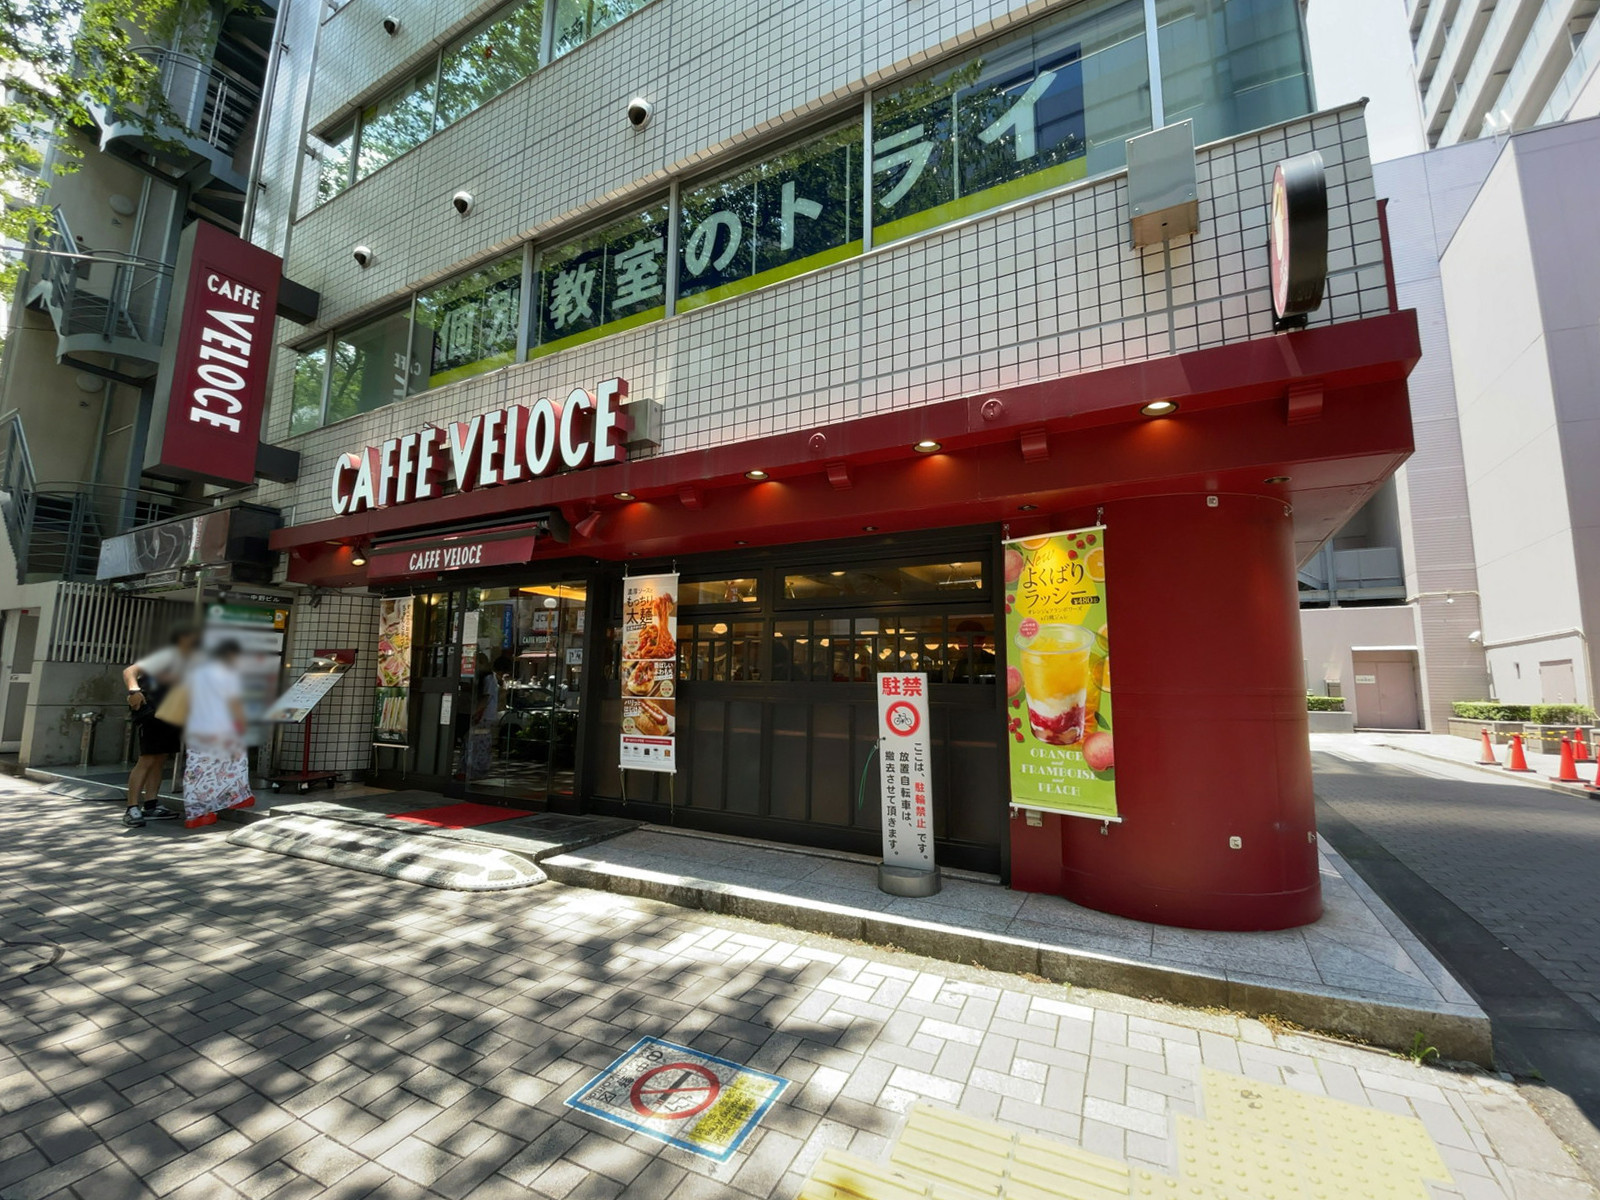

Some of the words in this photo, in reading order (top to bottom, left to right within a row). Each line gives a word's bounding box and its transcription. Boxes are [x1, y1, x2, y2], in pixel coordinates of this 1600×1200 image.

[190, 309, 255, 433] VELOCE
[449, 377, 625, 491] VELOCE
[443, 544, 482, 568] VELOCE
[1023, 562, 1084, 589] よくばり
[627, 595, 653, 607] もっちり
[1024, 587, 1087, 609] ラッシー
[626, 608, 653, 625] 太麺
[881, 676, 922, 697] 駐禁
[1030, 748, 1083, 761] ORANGE
[899, 751, 913, 827] 放置自転車は、
[1038, 783, 1080, 796] PEACH
[884, 751, 899, 856] 撤去させて頂きます。
